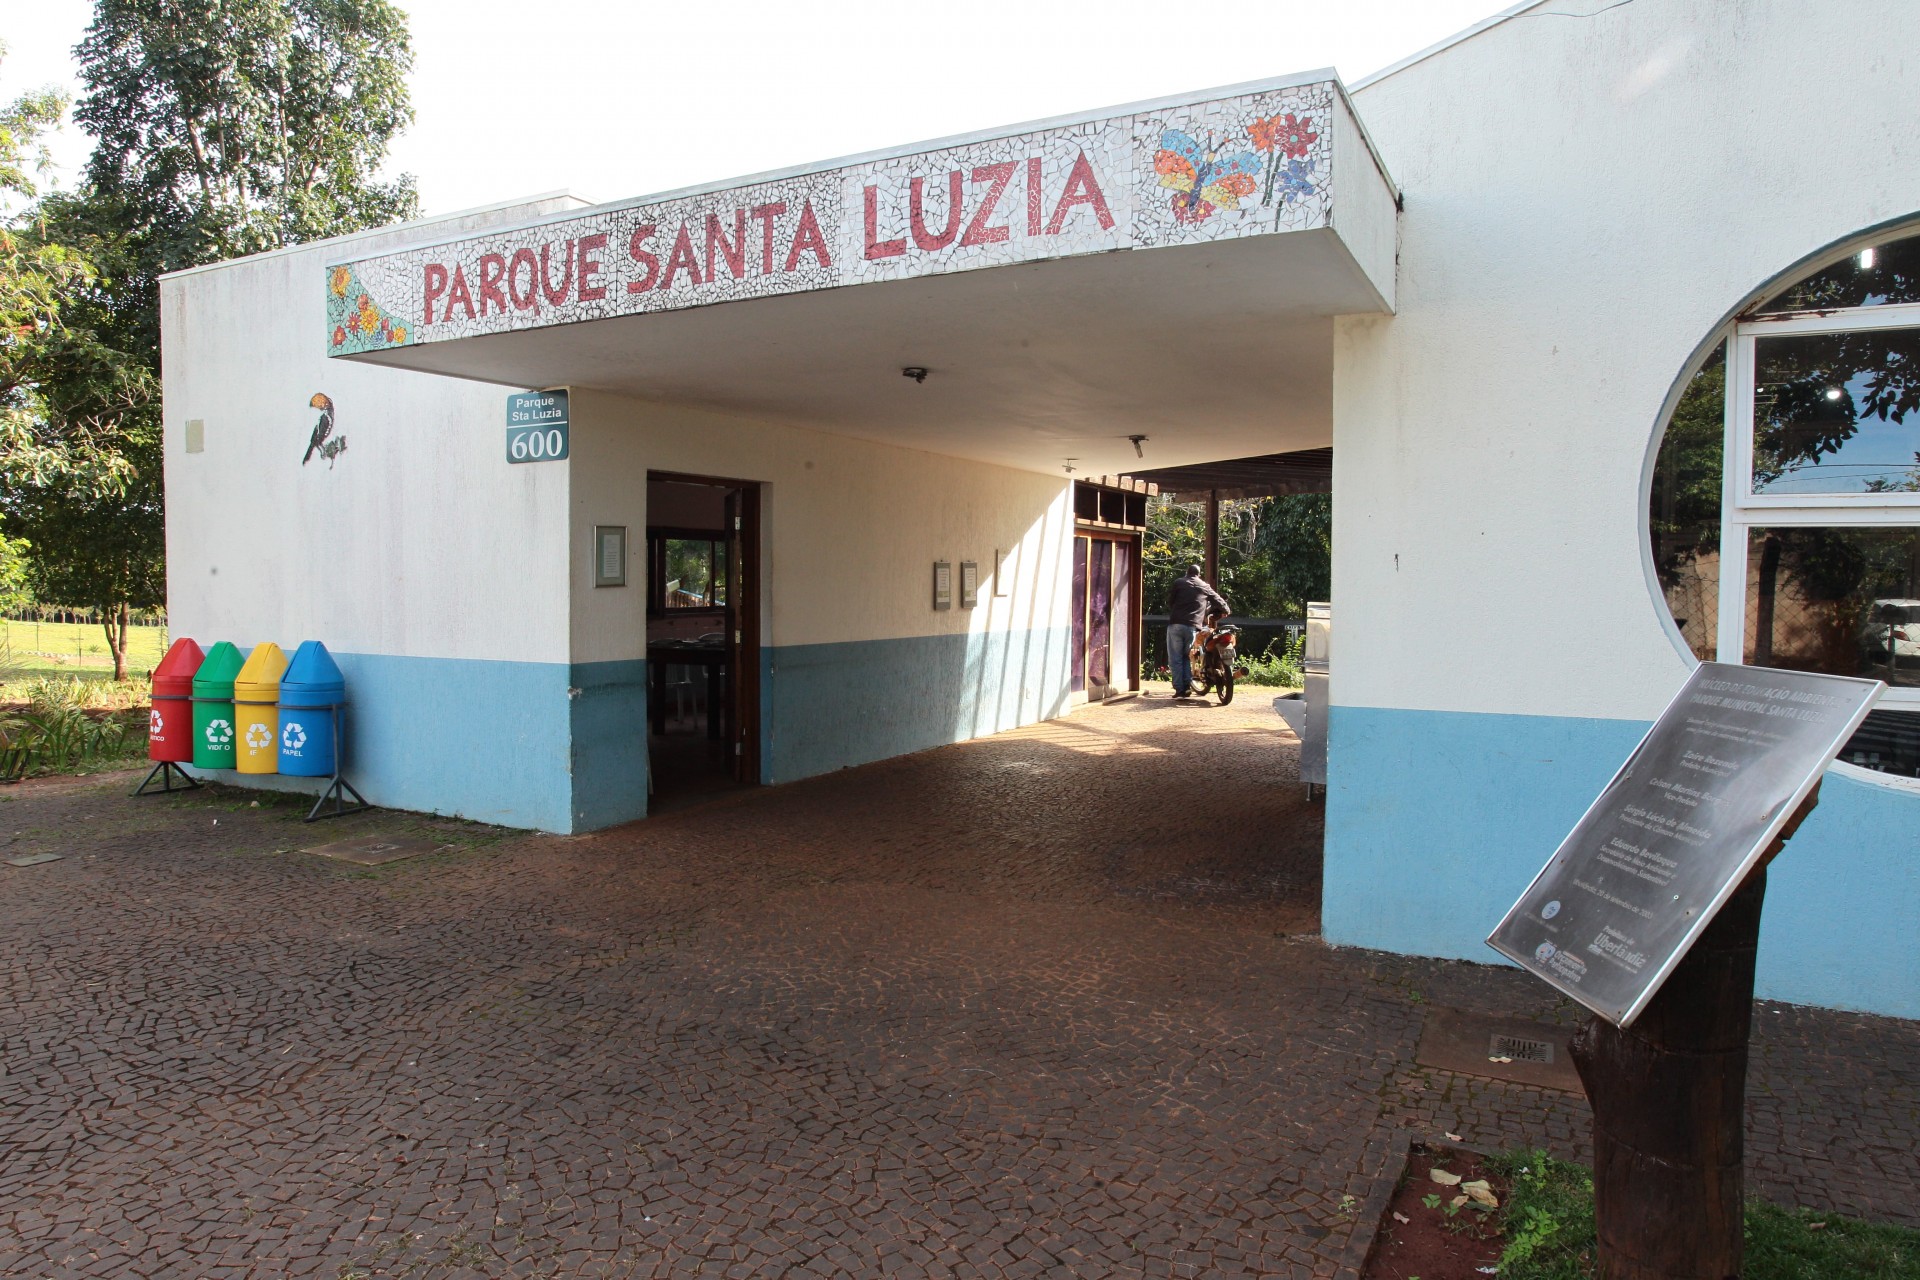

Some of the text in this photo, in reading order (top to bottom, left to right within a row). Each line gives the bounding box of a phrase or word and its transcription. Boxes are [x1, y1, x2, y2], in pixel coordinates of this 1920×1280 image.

[423, 149, 1115, 325] PARQUE SANTA LUZIA
[512, 408, 562, 421] Sta Luzia
[516, 397, 555, 409] Parque
[511, 429, 563, 459] 600
[1690, 693, 1723, 706] PARQUE
[1720, 698, 1767, 714] MUNICIPAL
[1766, 705, 1798, 718] SANTA
[1729, 683, 1744, 693] DE
[1788, 691, 1843, 707] AMBIENT
[282, 749, 303, 757] PAPEL
